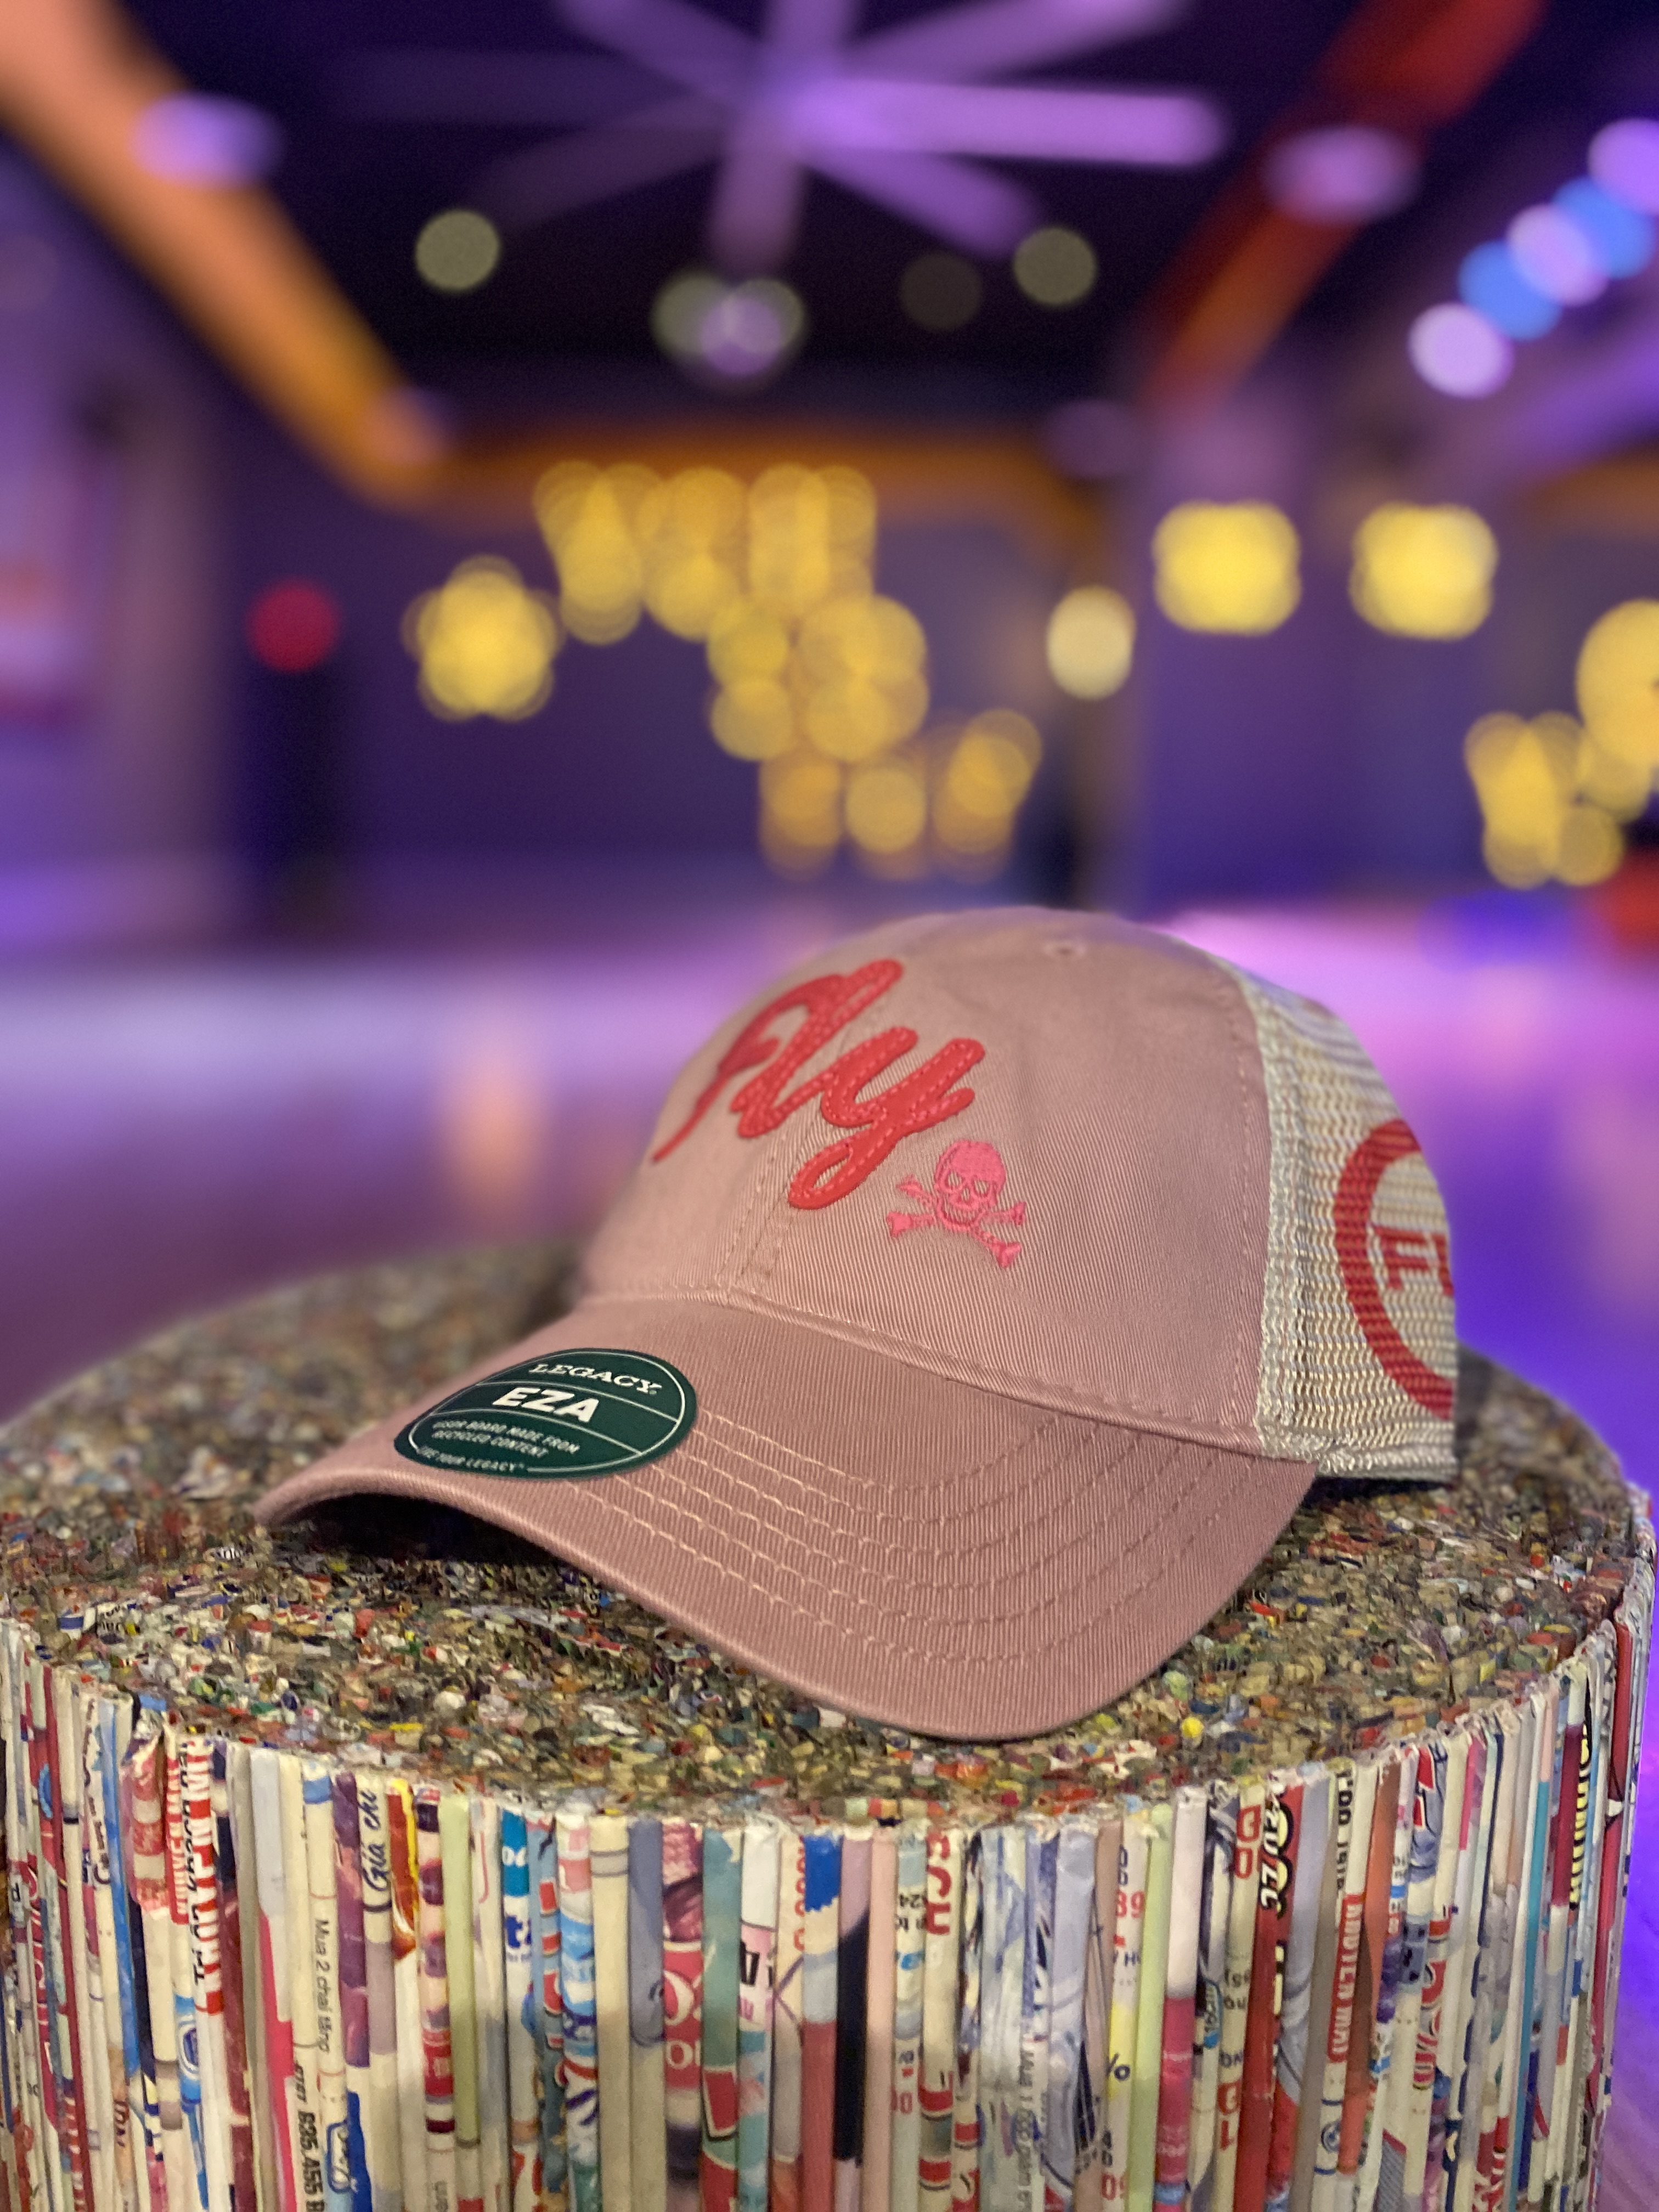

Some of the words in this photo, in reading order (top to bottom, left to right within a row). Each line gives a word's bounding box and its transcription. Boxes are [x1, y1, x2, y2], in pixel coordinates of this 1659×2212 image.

[652, 958, 986, 1209] Fly
[528, 1364, 662, 1394] LEGACY
[493, 1386, 600, 1423] EZA
